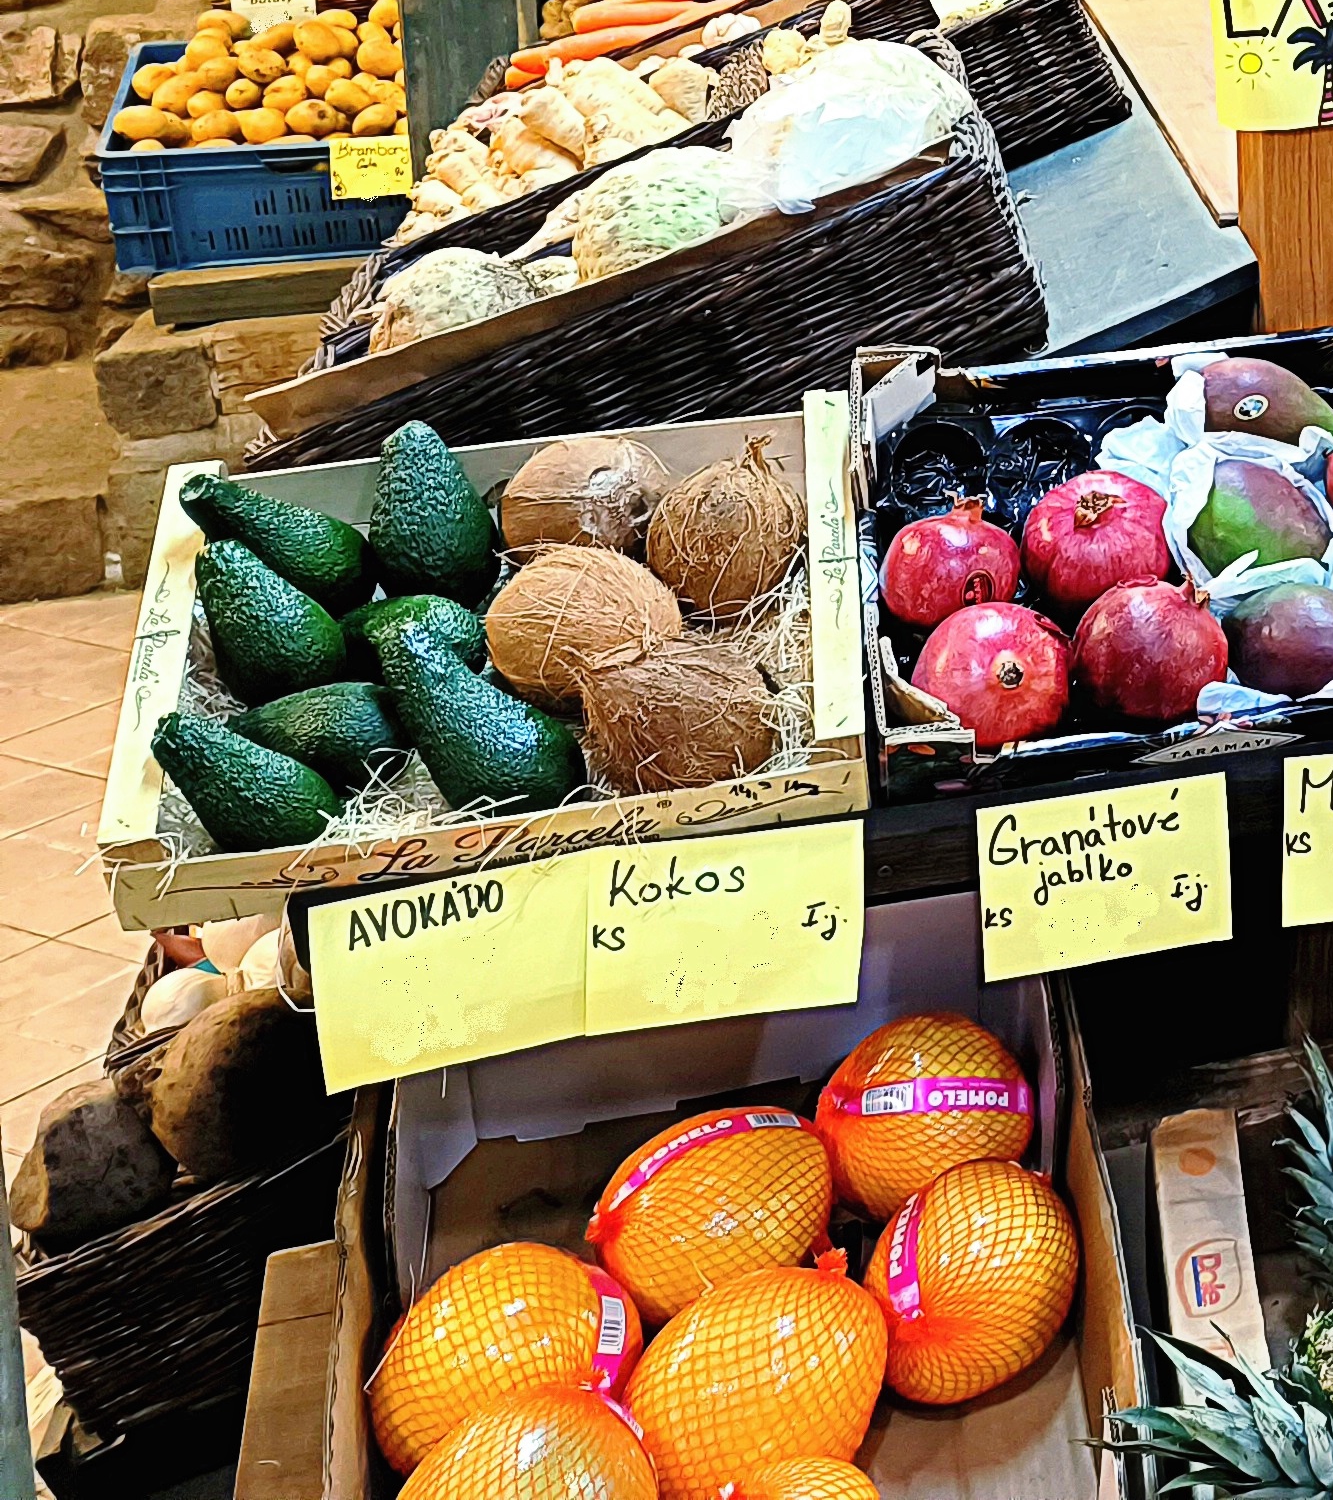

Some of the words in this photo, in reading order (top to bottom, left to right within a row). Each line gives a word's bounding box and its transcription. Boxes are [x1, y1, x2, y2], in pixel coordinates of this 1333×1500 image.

[988, 788, 1181, 866] Granátové
[609, 856, 746, 907] Kokos
[1034, 854, 1133, 905] jablko
[927, 1089, 1010, 1108] POMELO
[638, 1117, 734, 1173] POMELO
[1197, 1253, 1226, 1306] Dole
